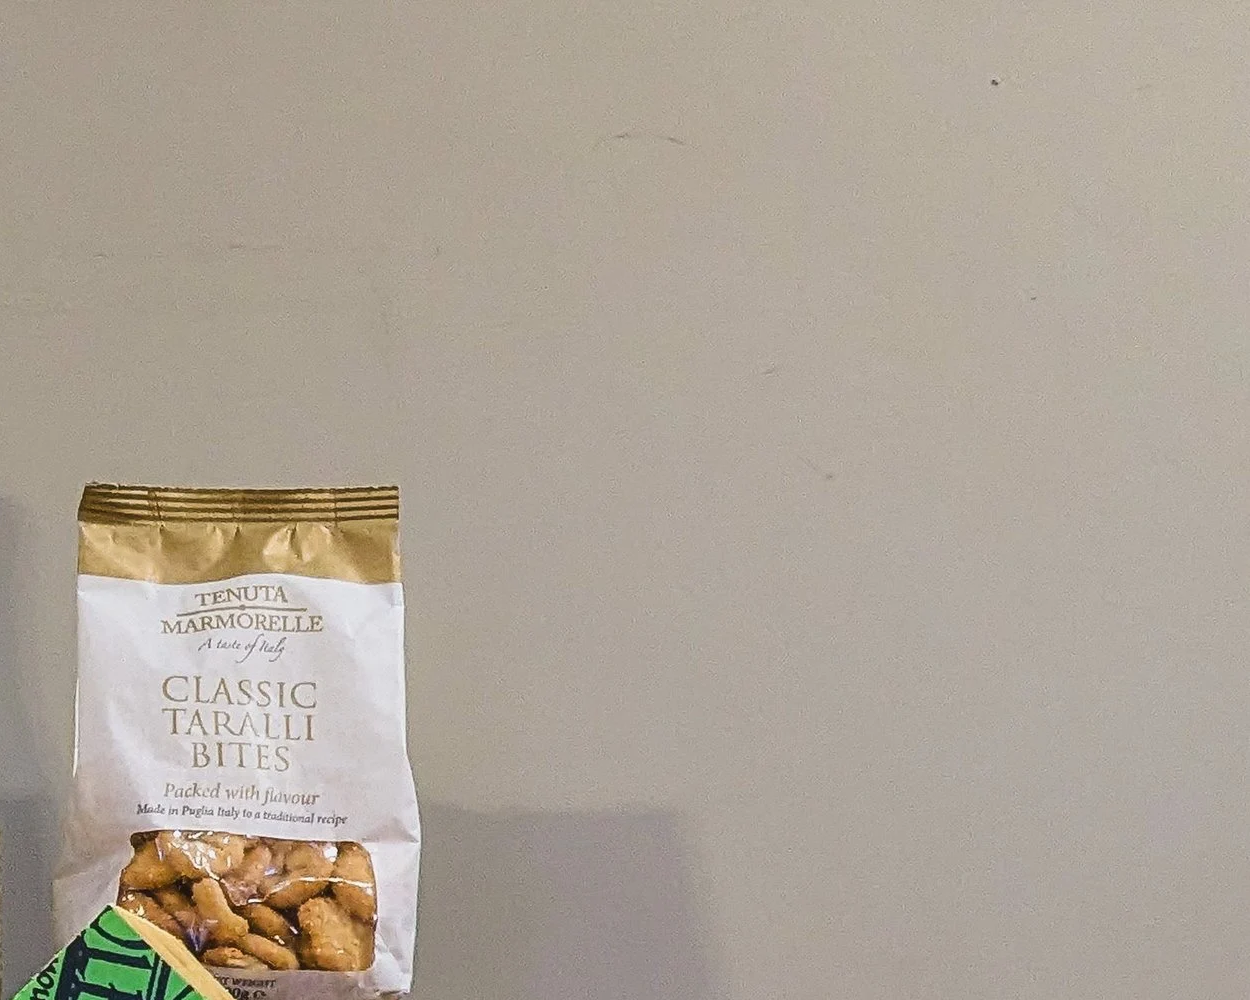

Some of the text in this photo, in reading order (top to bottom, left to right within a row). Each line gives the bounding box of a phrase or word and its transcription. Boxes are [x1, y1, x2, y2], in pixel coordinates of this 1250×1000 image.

[194, 585, 288, 606] TENUTA
[161, 613, 324, 634] MARMORELLE
[198, 633, 287, 664] A taste of Italy
[162, 675, 317, 709] CLASSIC
[162, 708, 315, 741] TARALLI
[191, 742, 290, 772] BITES
[163, 783, 320, 806] Packed with flavour
[137, 803, 348, 828] Made in Puglia Italy to a traditional recipe
